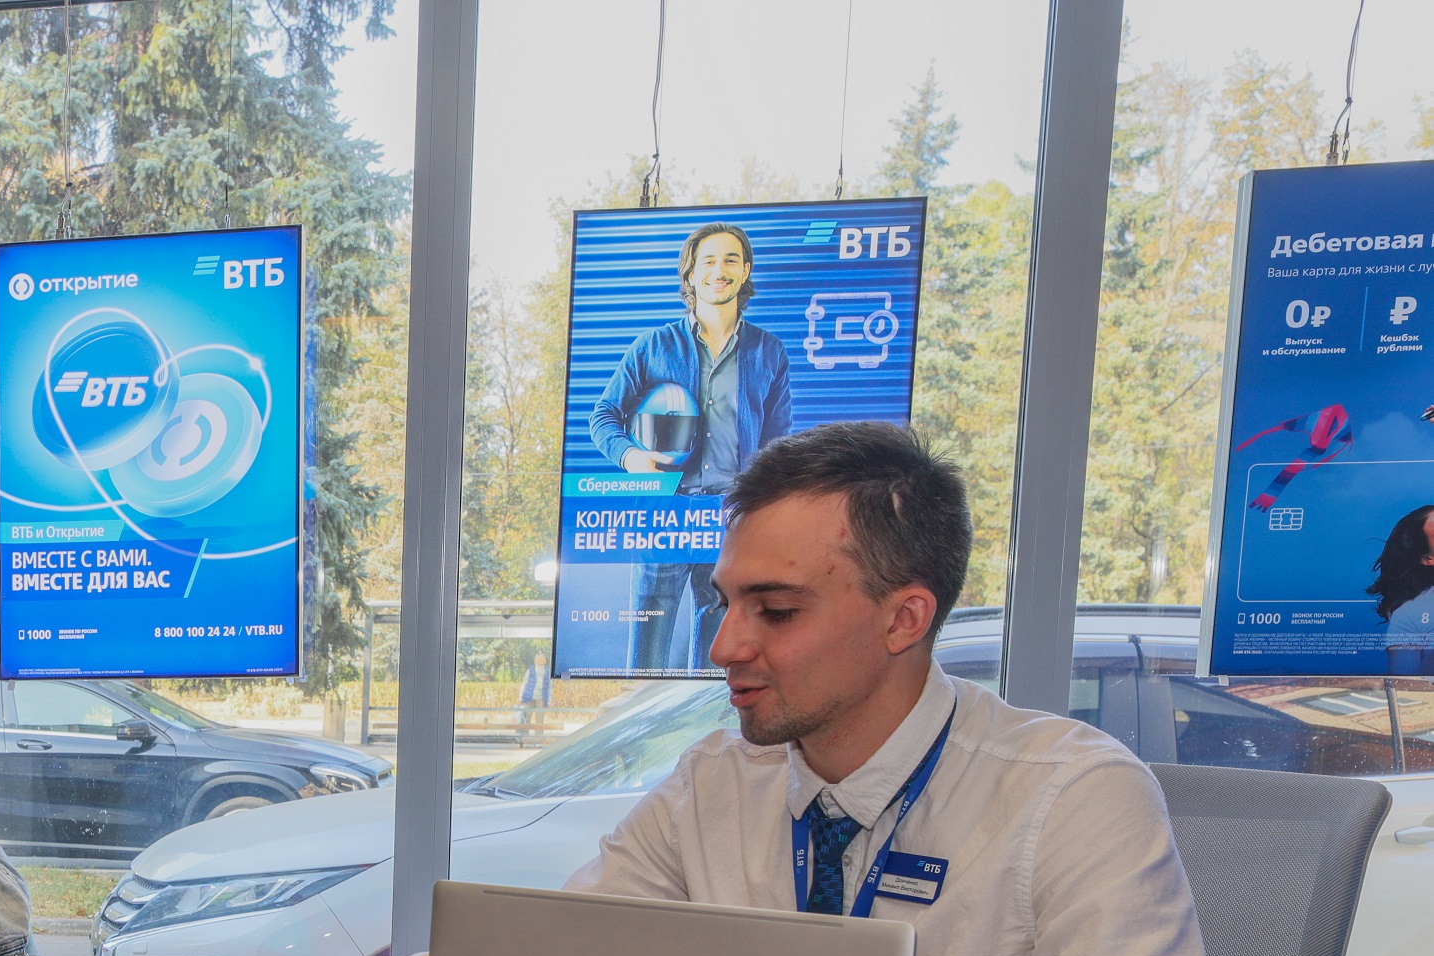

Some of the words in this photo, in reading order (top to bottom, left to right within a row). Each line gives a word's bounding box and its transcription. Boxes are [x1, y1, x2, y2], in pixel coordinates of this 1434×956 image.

[839, 225, 911, 260] ВТБ
[1270, 232, 1424, 259] Дебетовая
[223, 257, 285, 290] ВТБ
[1267, 267, 1299, 278] Ваша
[1302, 266, 1336, 278] карта
[1338, 265, 1362, 277] для
[1364, 264, 1405, 275] жизни
[1408, 263, 1416, 273] с
[39, 273, 139, 295] открытие
[1285, 337, 1323, 347] Выпуск
[1380, 333, 1419, 343] Кешбэк
[1270, 346, 1347, 357] обслуживание
[1377, 344, 1423, 354] рублями
[81, 376, 150, 408] ВТБ
[578, 477, 660, 495] Сбережения
[576, 510, 647, 528] КОПИТЕ
[652, 509, 678, 527] НА
[684, 509, 730, 527] МЕЧ
[11, 526, 33, 539] ВТБ
[36, 529, 44, 538] и
[46, 525, 105, 540] Открытие
[574, 529, 617, 553] ЕЩЁ
[623, 531, 721, 550] БЫСТРЕЕ!
[12, 551, 76, 569] ВМЕСТЕ
[81, 551, 92, 568] С
[97, 549, 152, 567] ВАМИ.
[12, 572, 83, 591] ВМЕСТЕ
[87, 571, 128, 593] ДЛЯ
[133, 570, 170, 589] ВАС
[581, 610, 610, 622] 1000
[1249, 613, 1281, 625] 1000
[1421, 612, 1430, 624] 8
[27, 629, 51, 640] 1000
[154, 627, 162, 638] 8
[164, 627, 183, 638] 800
[186, 626, 205, 637] 100
[207, 626, 220, 637] 24
[223, 625, 236, 637] 24
[245, 624, 283, 636] VTB.RU
[796, 848, 805, 867] ВТБ
[868, 865, 880, 883] ВТБ
[924, 863, 941, 874] ВТБ
